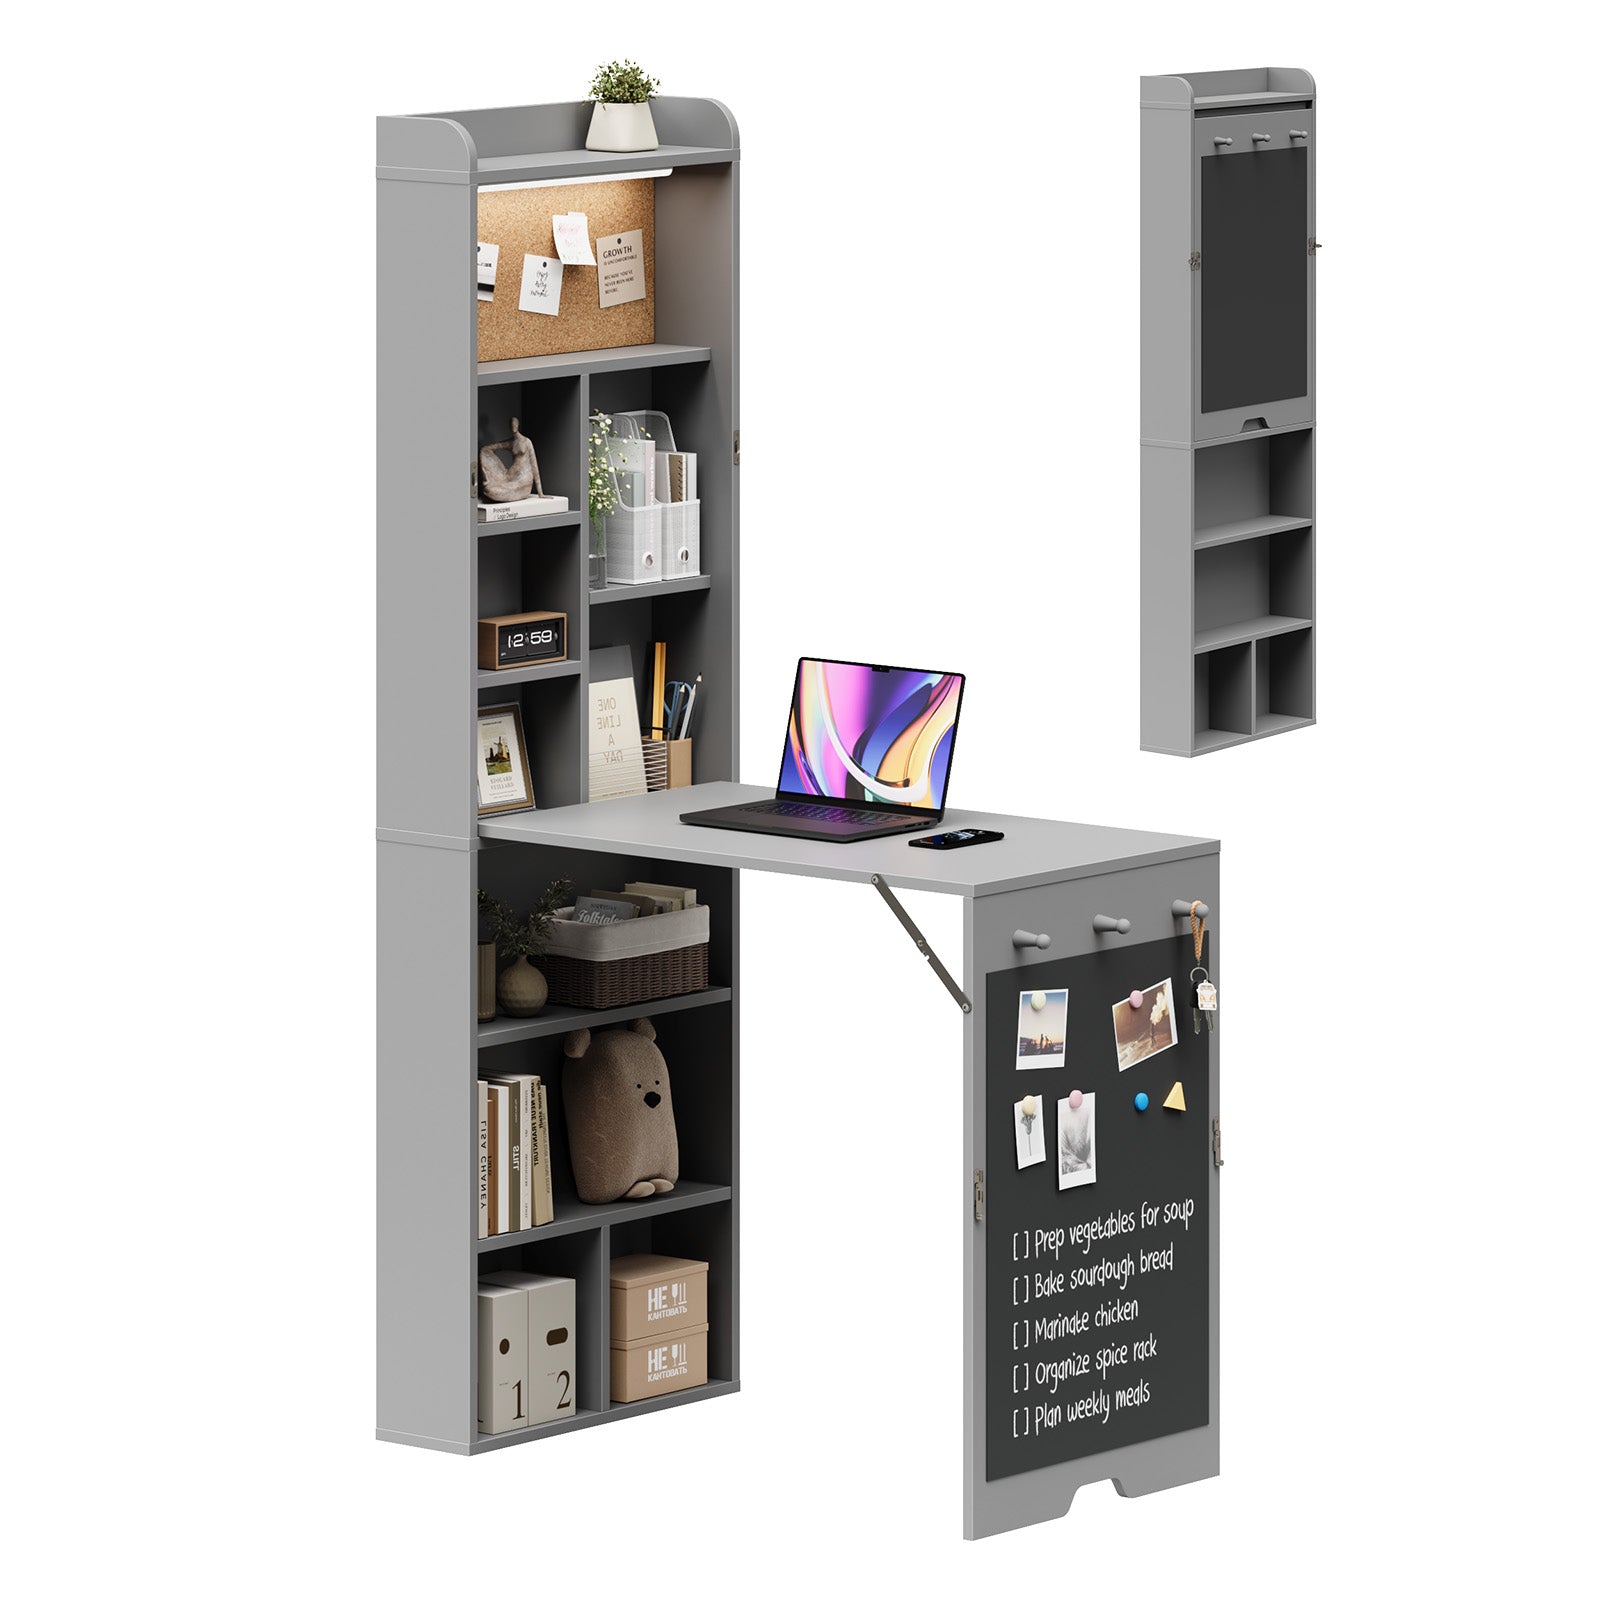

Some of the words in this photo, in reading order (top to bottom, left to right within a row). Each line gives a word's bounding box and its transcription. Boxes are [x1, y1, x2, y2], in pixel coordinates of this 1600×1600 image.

[602, 245, 632, 259] GROWTH
[1035, 1229, 1064, 1260] Prep
[1069, 1210, 1136, 1254] vegetables
[1141, 1201, 1160, 1229] for
[1163, 1198, 1194, 1230] soup
[1035, 1270, 1064, 1298] Bake
[1069, 1253, 1135, 1290] sourdough
[1140, 1241, 1174, 1274] bread
[647, 1305, 688, 1322] КАНТОВАТЬ
[648, 1285, 668, 1312] НЕ
[1035, 1310, 1090, 1343] Marinate
[1094, 1298, 1139, 1327] chicken
[647, 1366, 688, 1383] КАНТОВАТЬ
[648, 1346, 668, 1373] НЕ
[1035, 1352, 1090, 1393] Organize
[1095, 1342, 1128, 1381] spice
[1133, 1332, 1158, 1362] rack
[512, 1379, 526, 1420] 1
[556, 1370, 572, 1410] 2
[1035, 1402, 1062, 1436] Plan
[1067, 1388, 1110, 1425] weekly
[1115, 1378, 1151, 1411] meals
